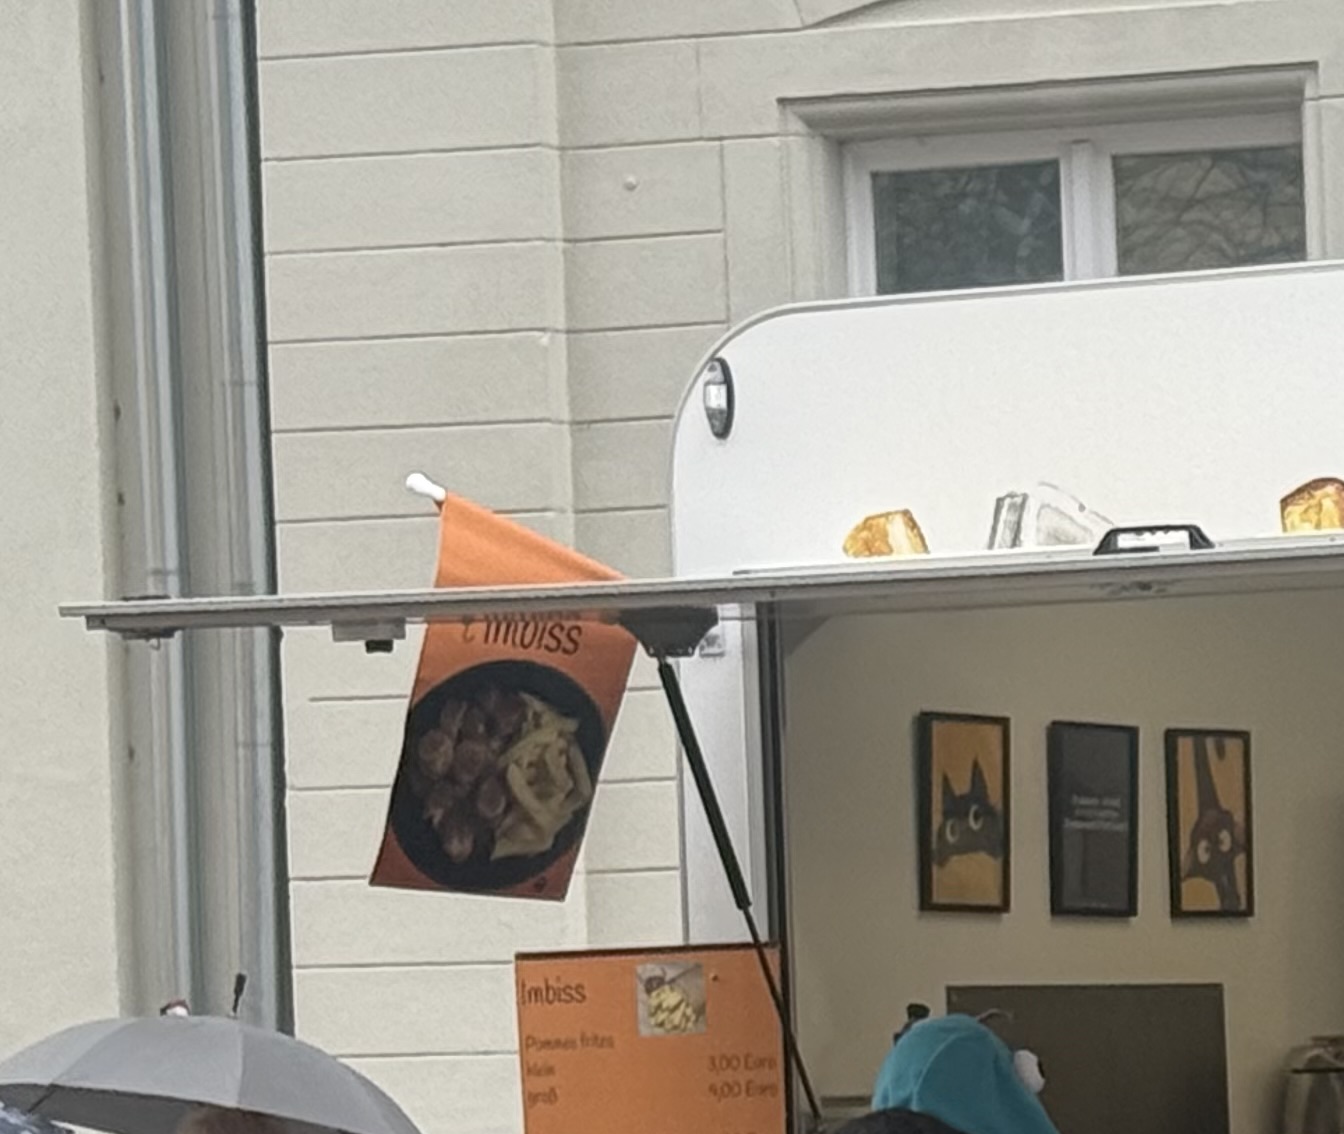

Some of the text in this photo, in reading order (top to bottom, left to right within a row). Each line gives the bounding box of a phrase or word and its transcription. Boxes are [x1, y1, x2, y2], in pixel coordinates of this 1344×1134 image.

[520, 976, 588, 1006] Imbiss
[744, 1053, 777, 1071] Euro
[745, 1081, 778, 1098] Euro
